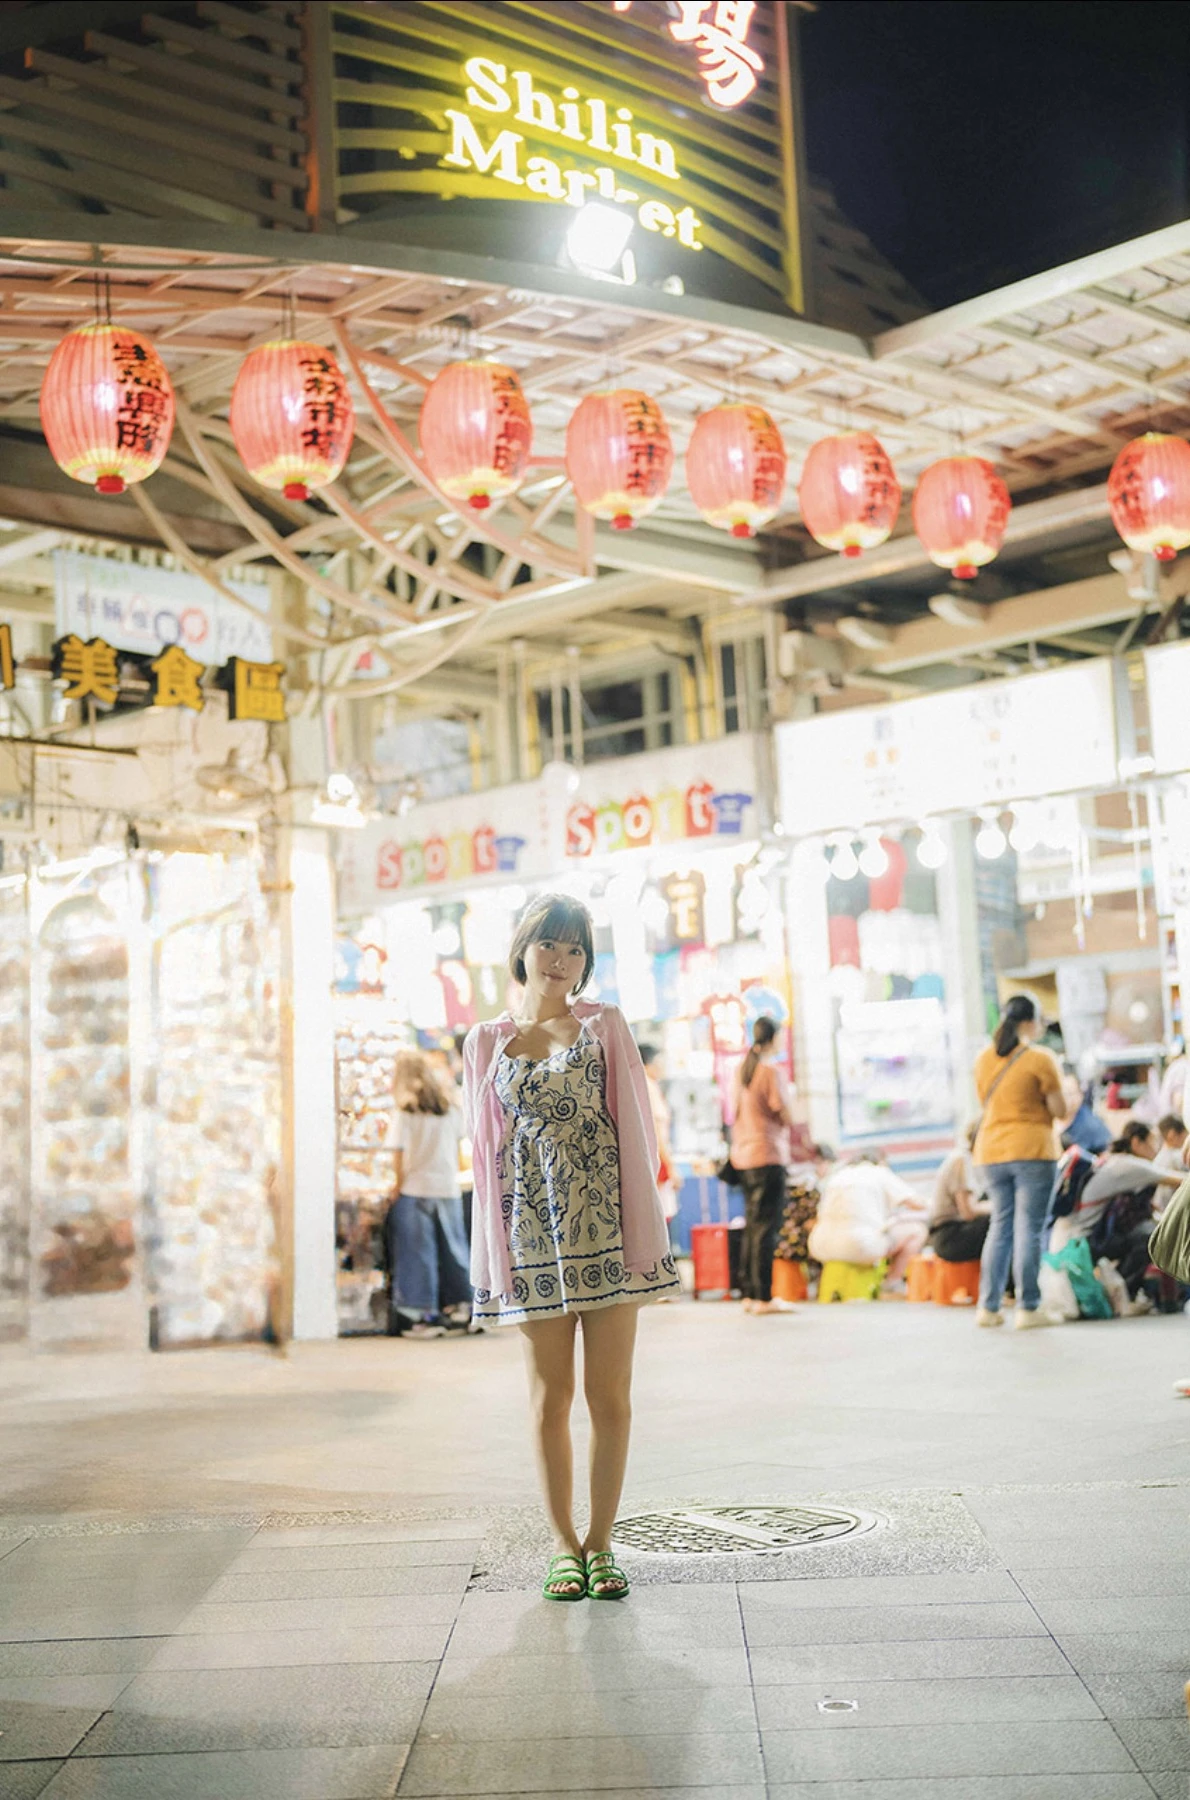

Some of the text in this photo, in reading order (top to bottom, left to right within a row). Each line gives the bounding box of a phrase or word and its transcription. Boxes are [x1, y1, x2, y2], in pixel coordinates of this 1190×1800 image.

[464, 56, 681, 180] Shilin
[0, 623, 285, 721] 美食區
[377, 825, 494, 888] Sport
[565, 780, 714, 857] Sport
